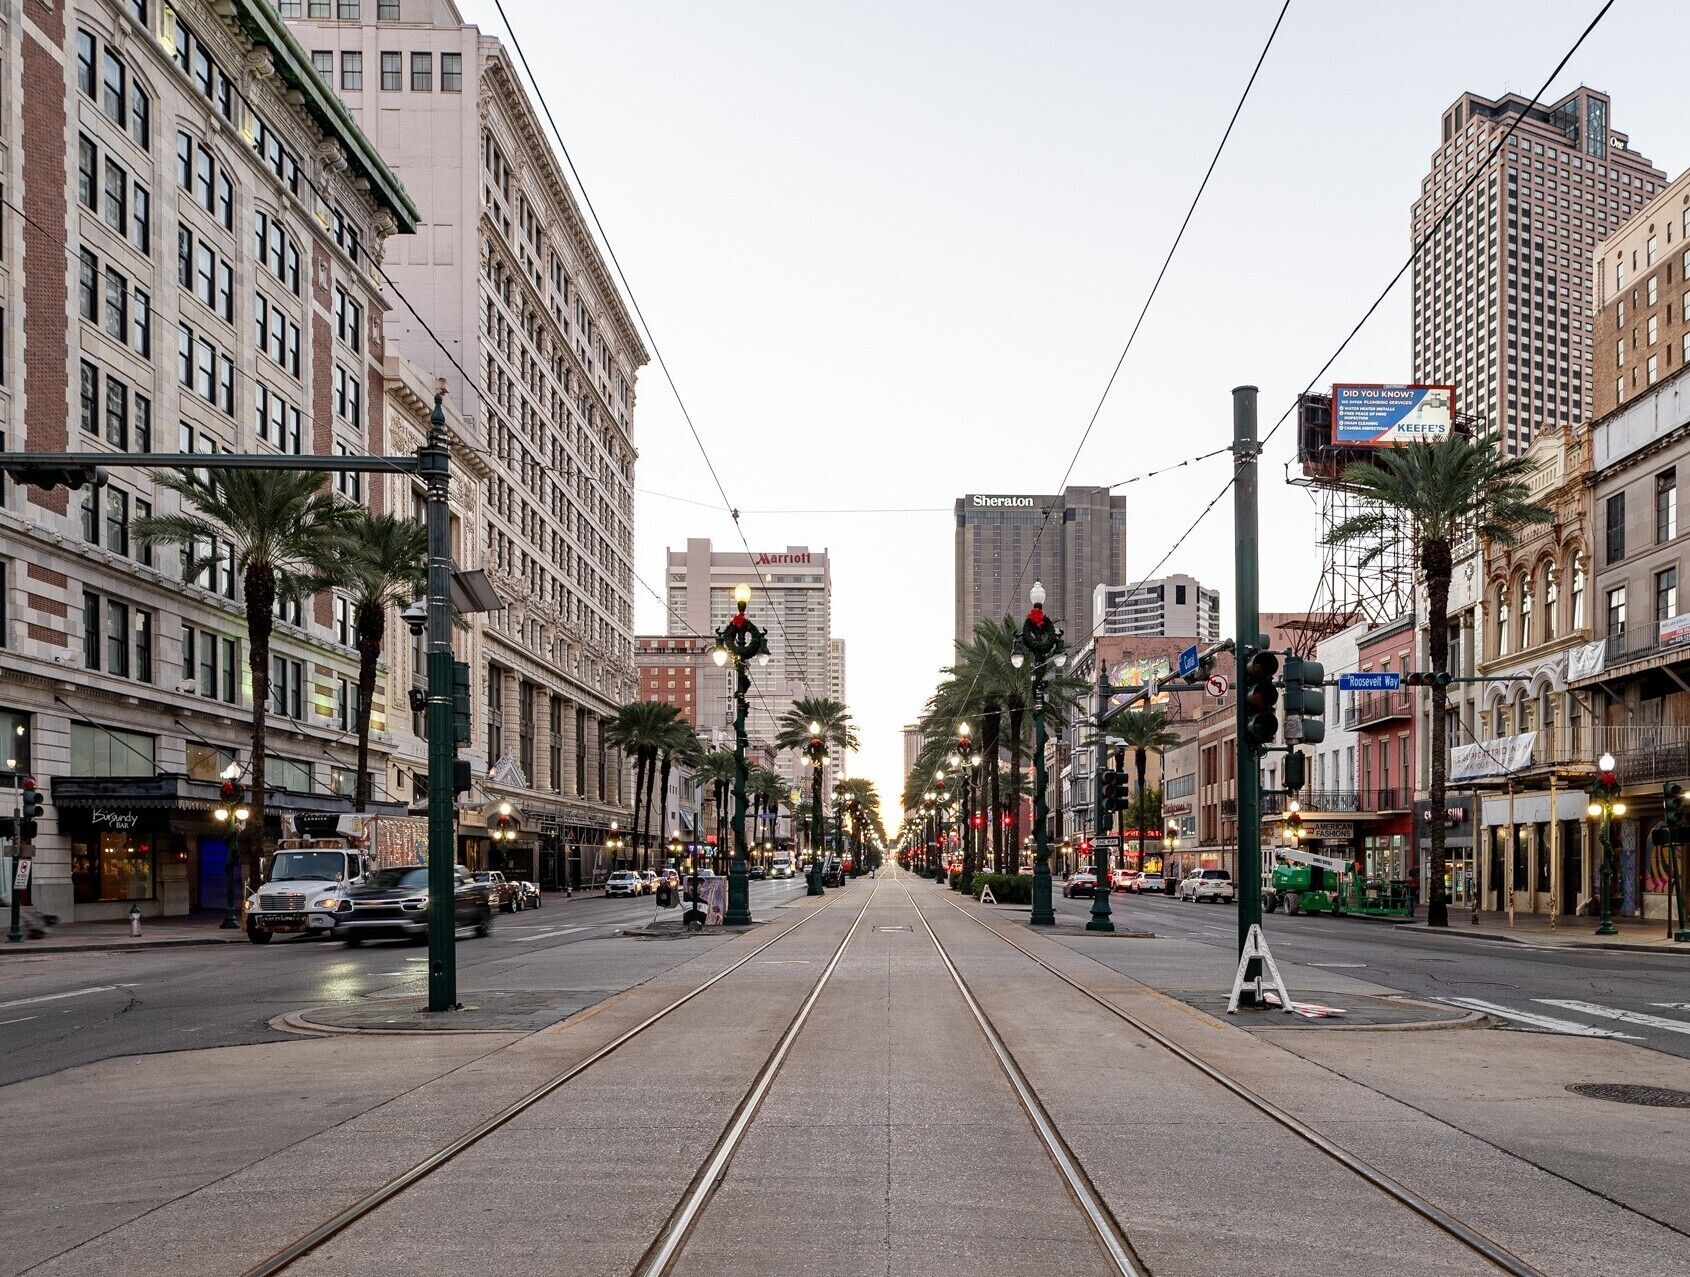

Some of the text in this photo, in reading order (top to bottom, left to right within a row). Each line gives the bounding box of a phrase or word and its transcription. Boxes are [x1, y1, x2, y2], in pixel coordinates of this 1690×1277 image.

[1398, 424, 1445, 432] KEEFE'S
[973, 495, 1034, 507] Sheraton
[756, 553, 811, 565] Marriott
[1184, 654, 1195, 670] Canal
[1350, 676, 1398, 689] Roosevelt Way
[92, 808, 138, 828] Burgundy
